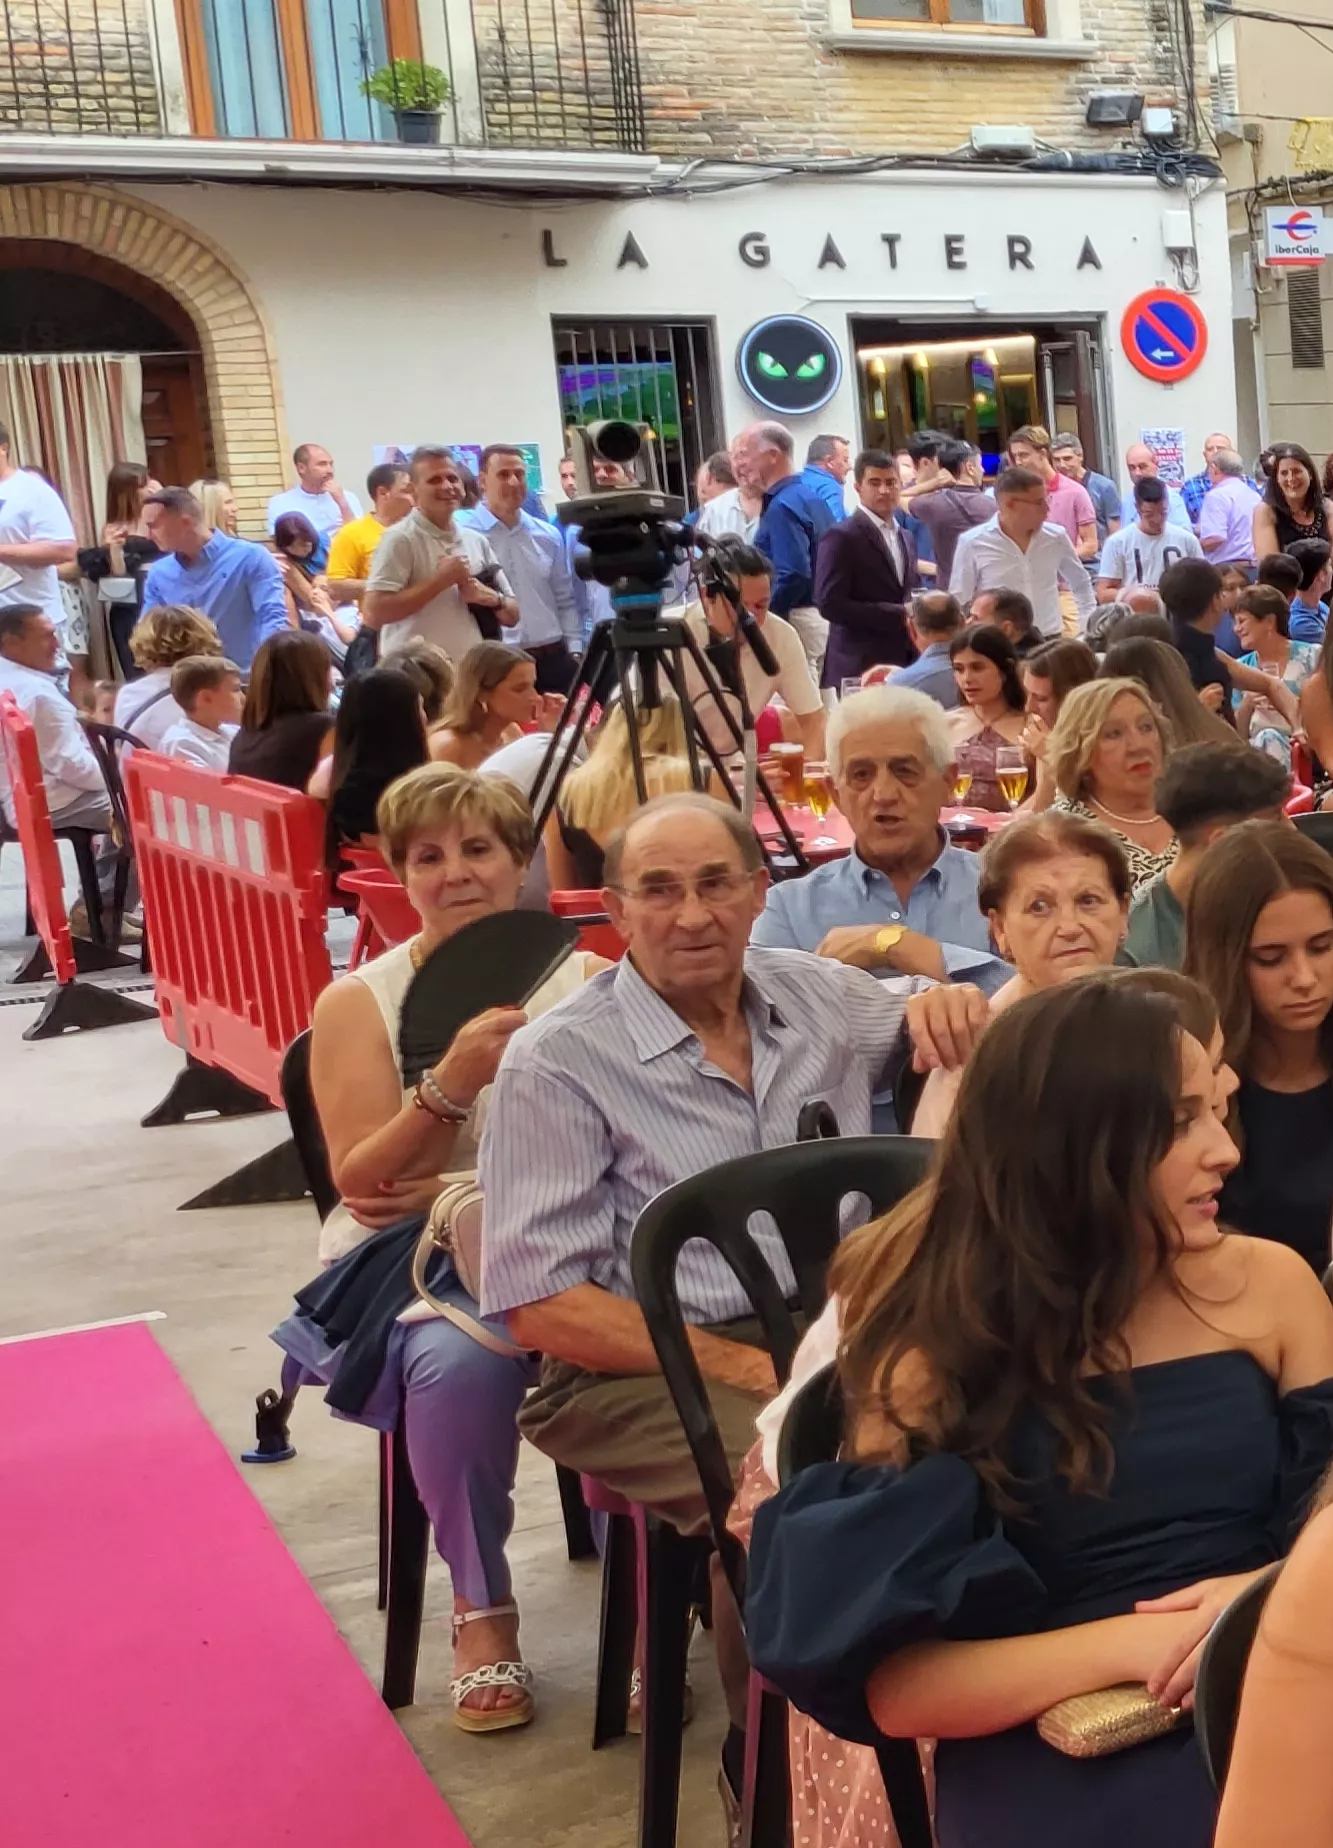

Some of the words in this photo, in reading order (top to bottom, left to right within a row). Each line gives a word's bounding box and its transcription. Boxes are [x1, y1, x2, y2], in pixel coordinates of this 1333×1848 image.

[542, 229, 648, 269] LA
[739, 233, 1101, 270] GATERA
[1275, 244, 1319, 256] iberCaja
